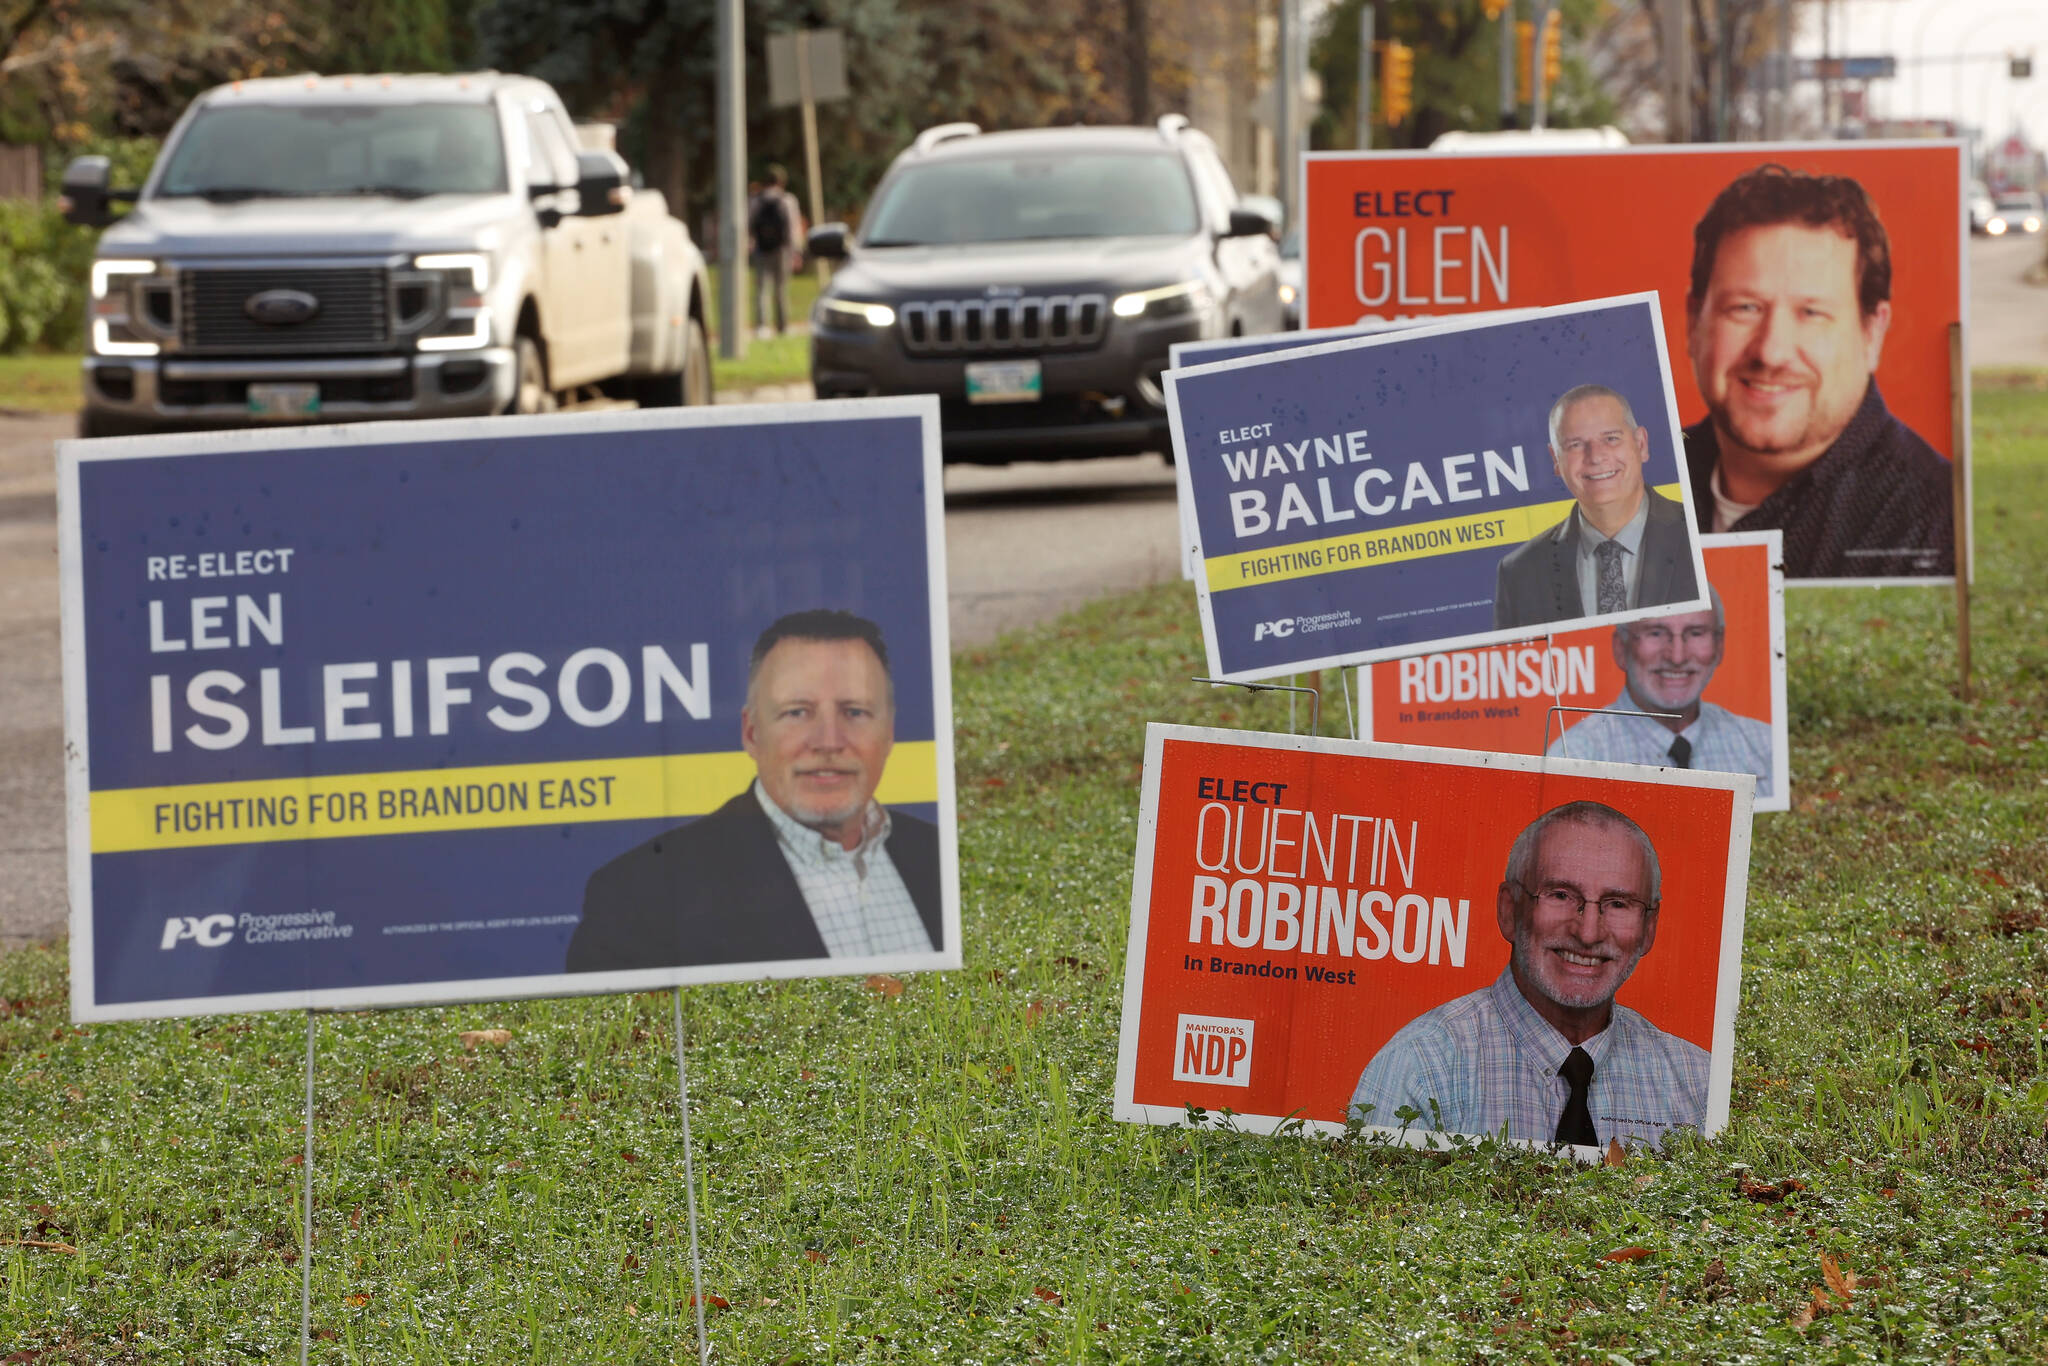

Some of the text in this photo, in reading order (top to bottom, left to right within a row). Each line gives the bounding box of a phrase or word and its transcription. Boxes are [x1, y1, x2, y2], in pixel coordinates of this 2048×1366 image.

[1354, 190, 1455, 217] ELECT
[1355, 226, 1508, 307] GLEN
[1219, 423, 1272, 444] ELECT
[1221, 430, 1372, 482] WAYNE
[1229, 445, 1529, 538] BALCAEN
[148, 549, 294, 581] RE-ELECT
[1241, 519, 1505, 578] FIGHTING FOR BRANDON WEST
[150, 593, 283, 652] LEN
[1296, 610, 1351, 626] Progressive
[1301, 617, 1362, 633] Conservative
[1400, 645, 1596, 704] ROBINSON
[151, 643, 711, 752] ISLEIFSON
[1400, 706, 1520, 723] In Brandon West
[155, 776, 616, 834] FIGHTING FOR BRANDON EAST
[1197, 777, 1288, 805] ELECT
[1195, 802, 1418, 888] QUENTIN
[238, 909, 336, 929] Progressive
[245, 924, 353, 944] Conservative
[1188, 874, 1470, 968] ROBINSON
[1183, 955, 1356, 984] In Brandon West
[1185, 1023, 1244, 1036] MANITOBA'S
[1182, 1032, 1247, 1078] NDP
